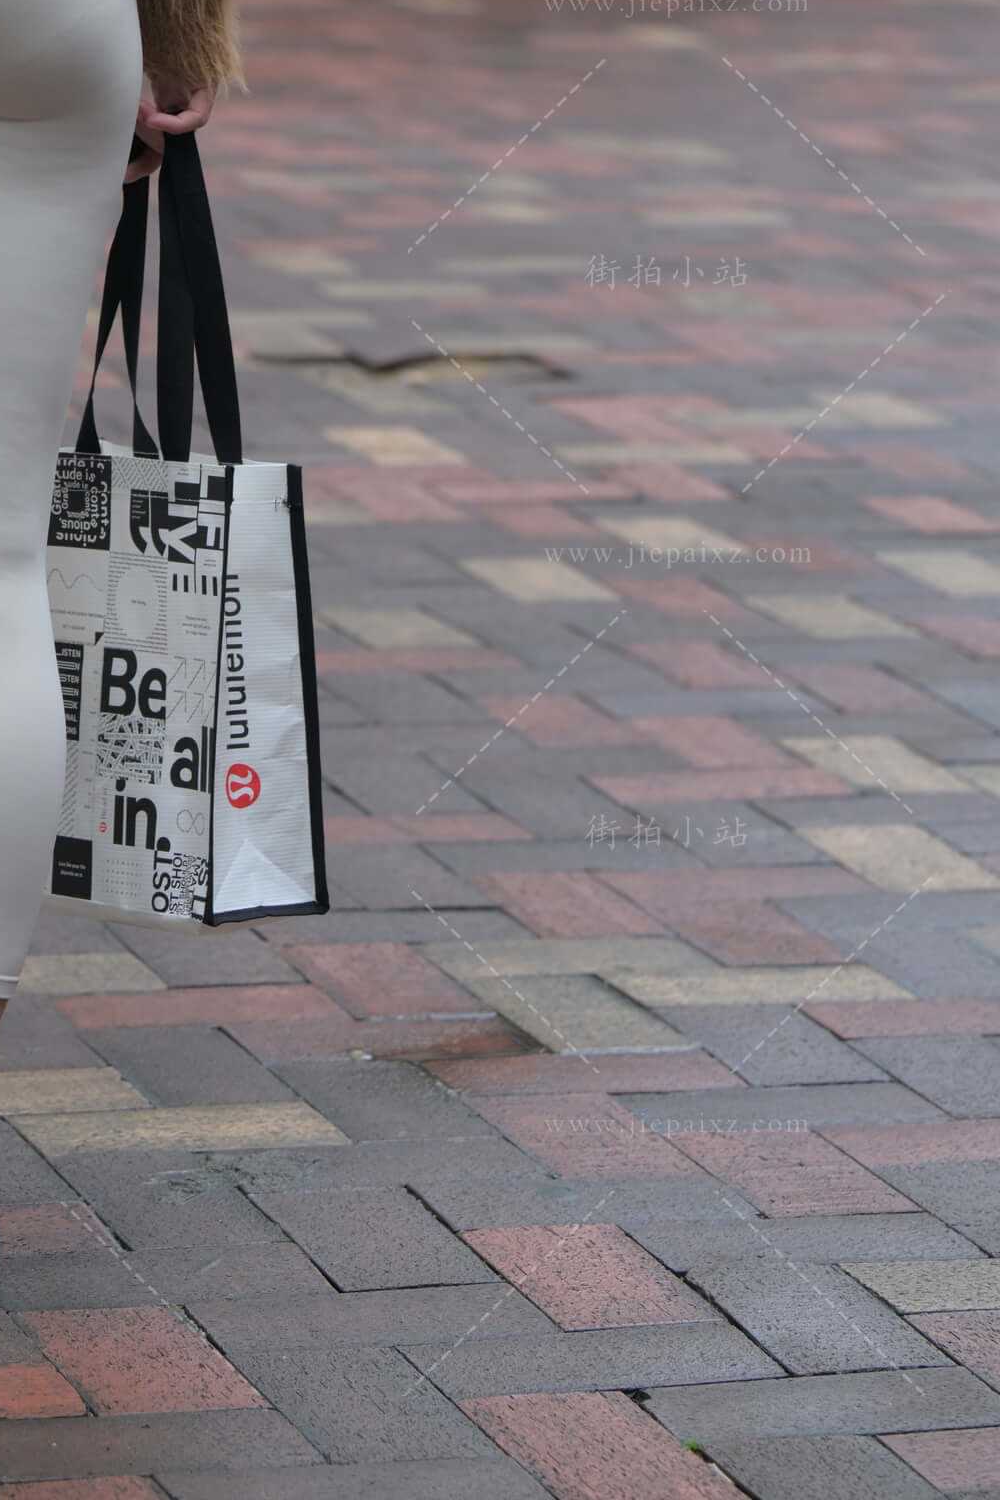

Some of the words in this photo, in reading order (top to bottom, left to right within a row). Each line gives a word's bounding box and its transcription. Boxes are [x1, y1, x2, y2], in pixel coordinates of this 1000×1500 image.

[100, 647, 167, 720] Be
[224, 574, 250, 750] lululemon
[170, 725, 215, 794] all
